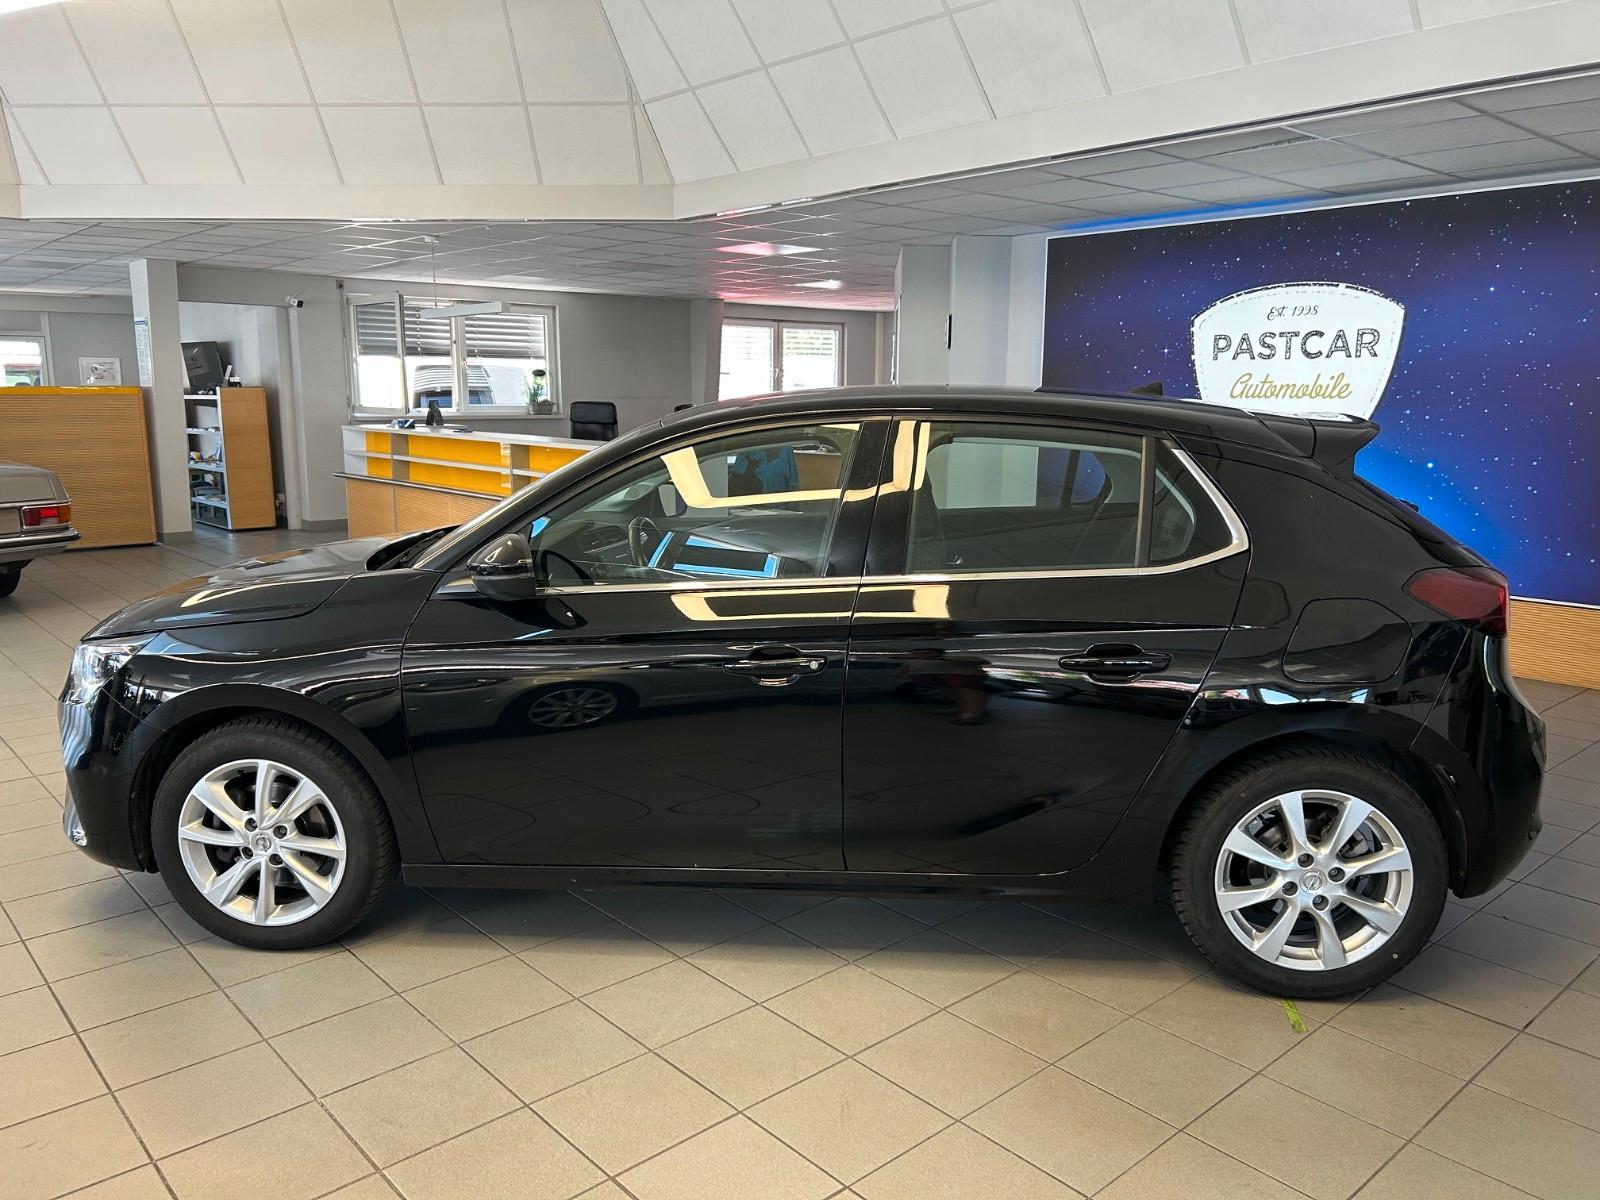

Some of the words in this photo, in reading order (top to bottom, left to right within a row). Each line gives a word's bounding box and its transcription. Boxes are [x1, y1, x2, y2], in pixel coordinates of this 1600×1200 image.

[1291, 304, 1320, 317] 1998
[1212, 328, 1381, 361] PASTCAR
[1230, 372, 1353, 399] Automobile
